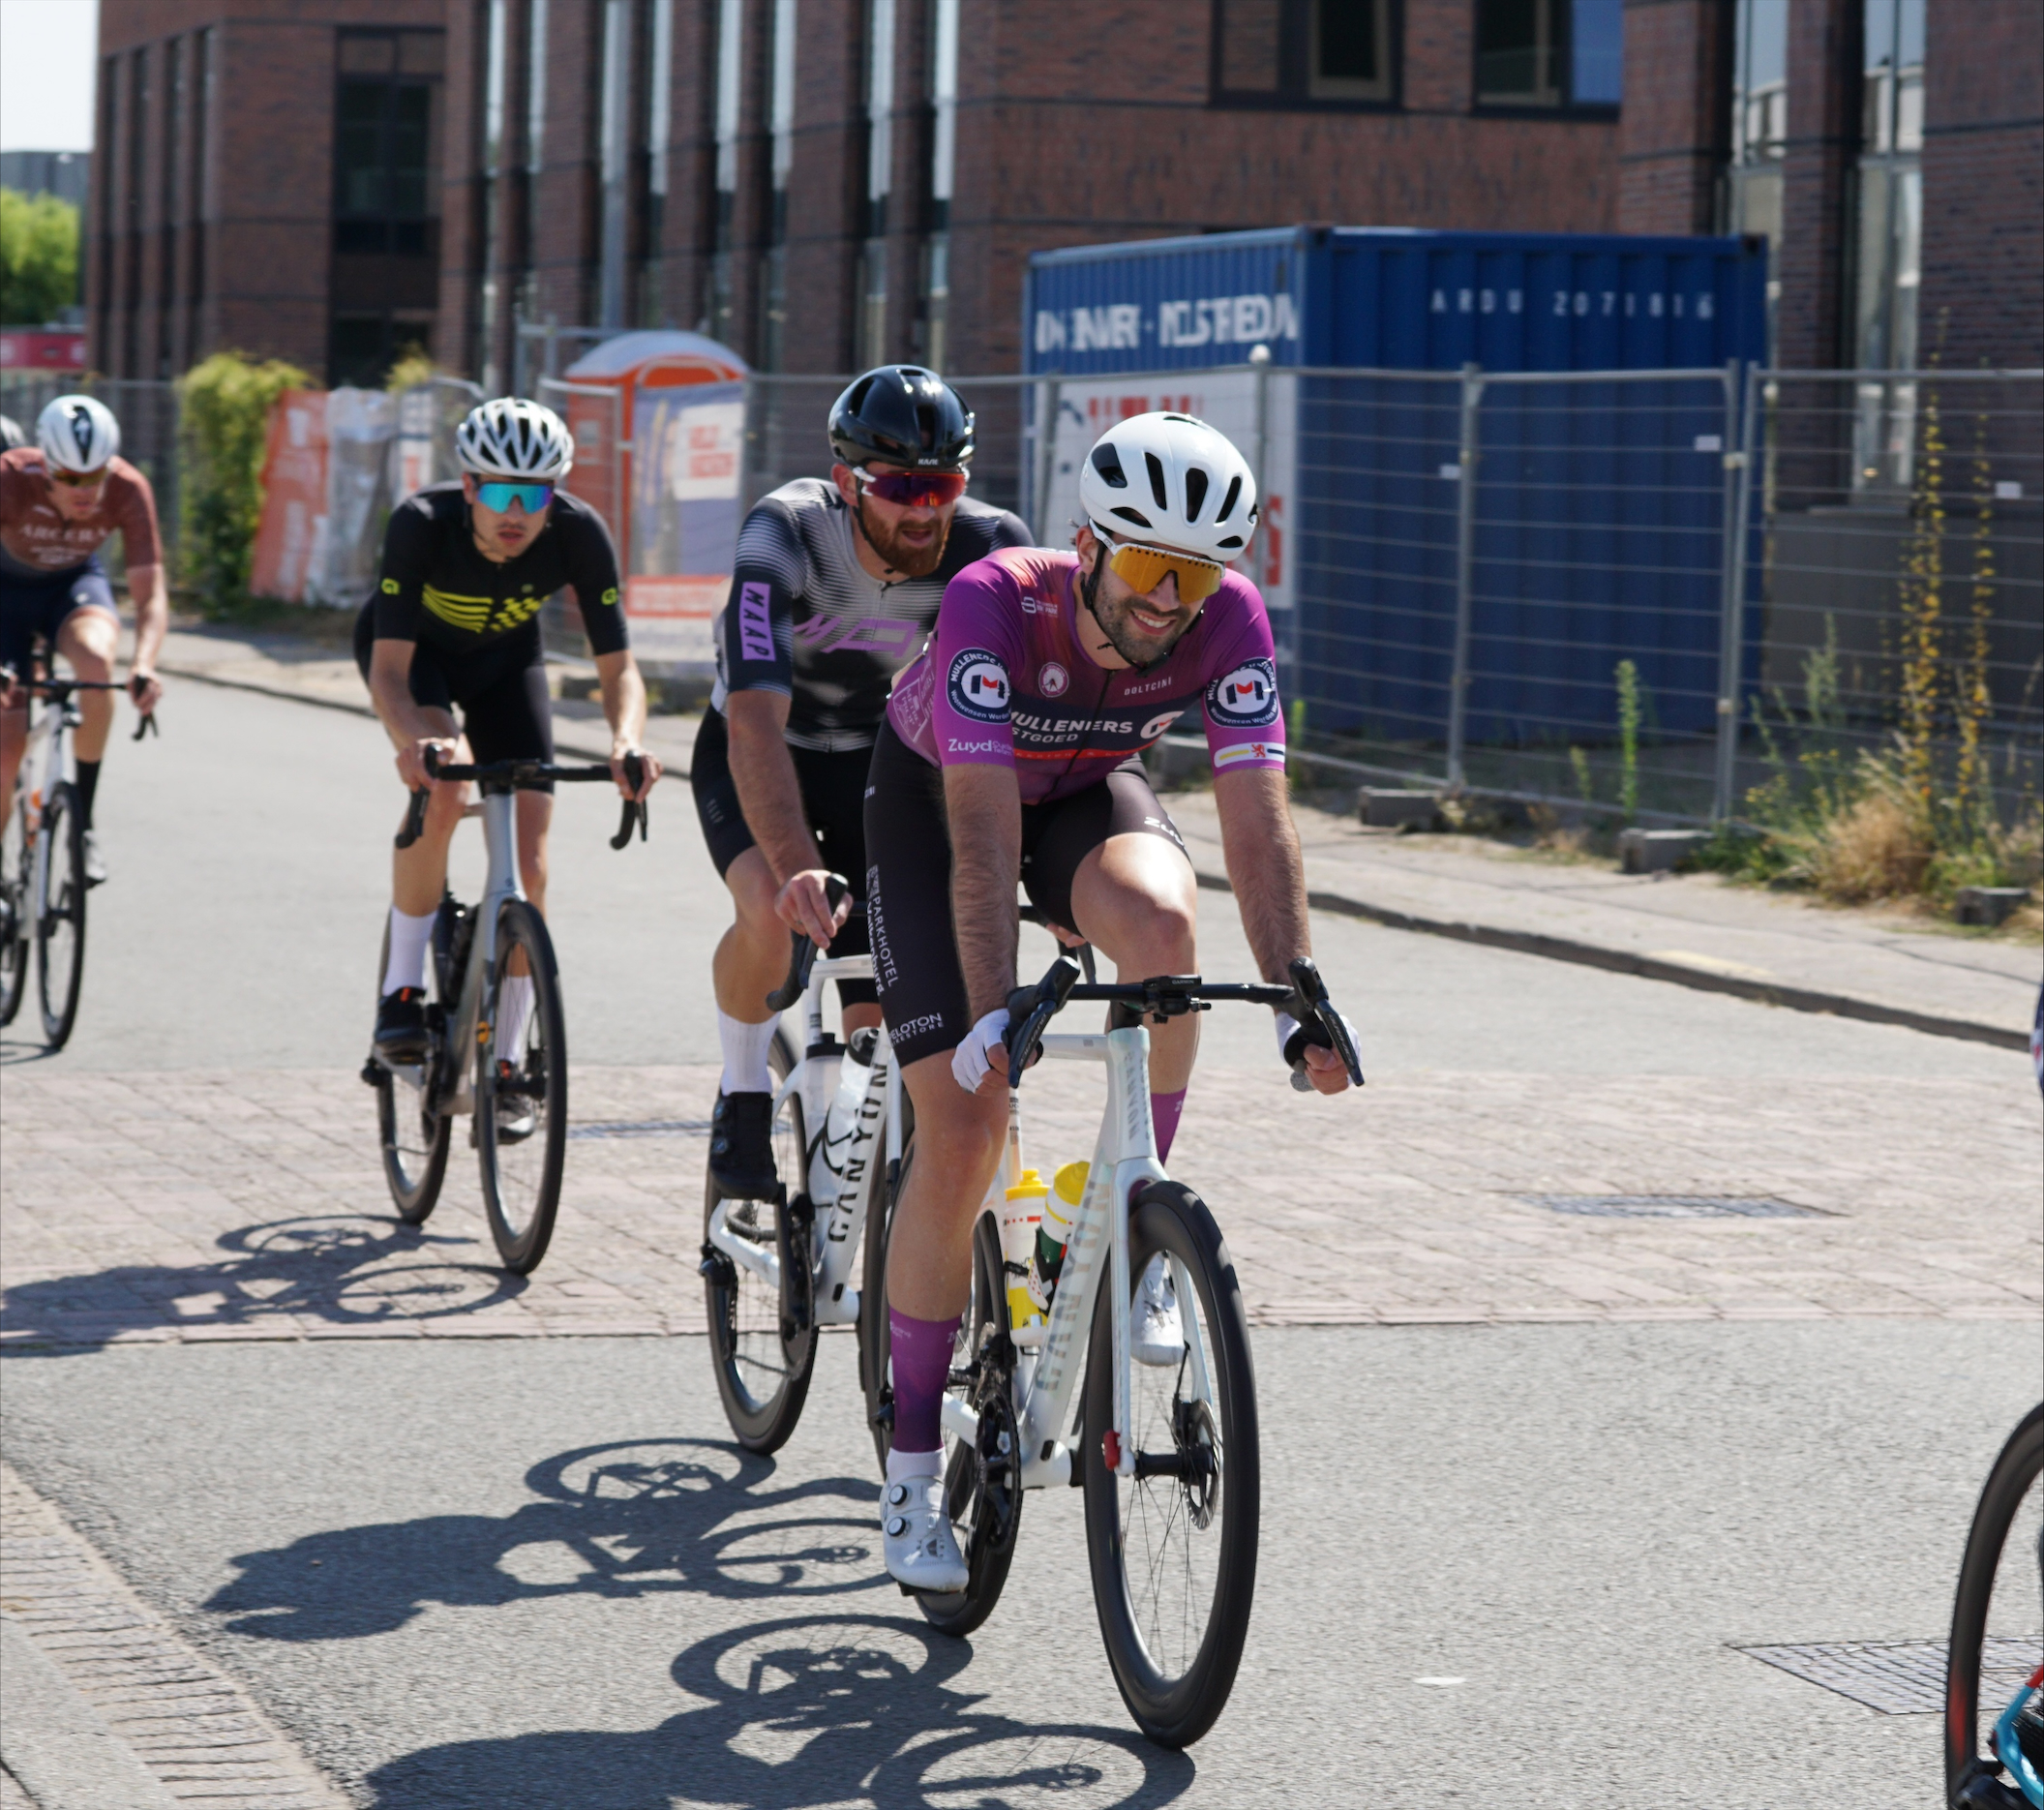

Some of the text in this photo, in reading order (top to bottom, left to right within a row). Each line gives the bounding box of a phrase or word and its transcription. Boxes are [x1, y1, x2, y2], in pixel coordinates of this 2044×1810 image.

[743, 588, 770, 656] MAAP
[950, 689, 987, 719] Woonwensen
[1124, 677, 1171, 696] DOLTCINI
[948, 739, 993, 753] Zuyd
[873, 895, 898, 987] PARKHOTEL
[889, 1012, 942, 1040] ELOTON
[827, 1063, 887, 1242] CANYON
[1035, 1180, 1111, 1391] CANYON
